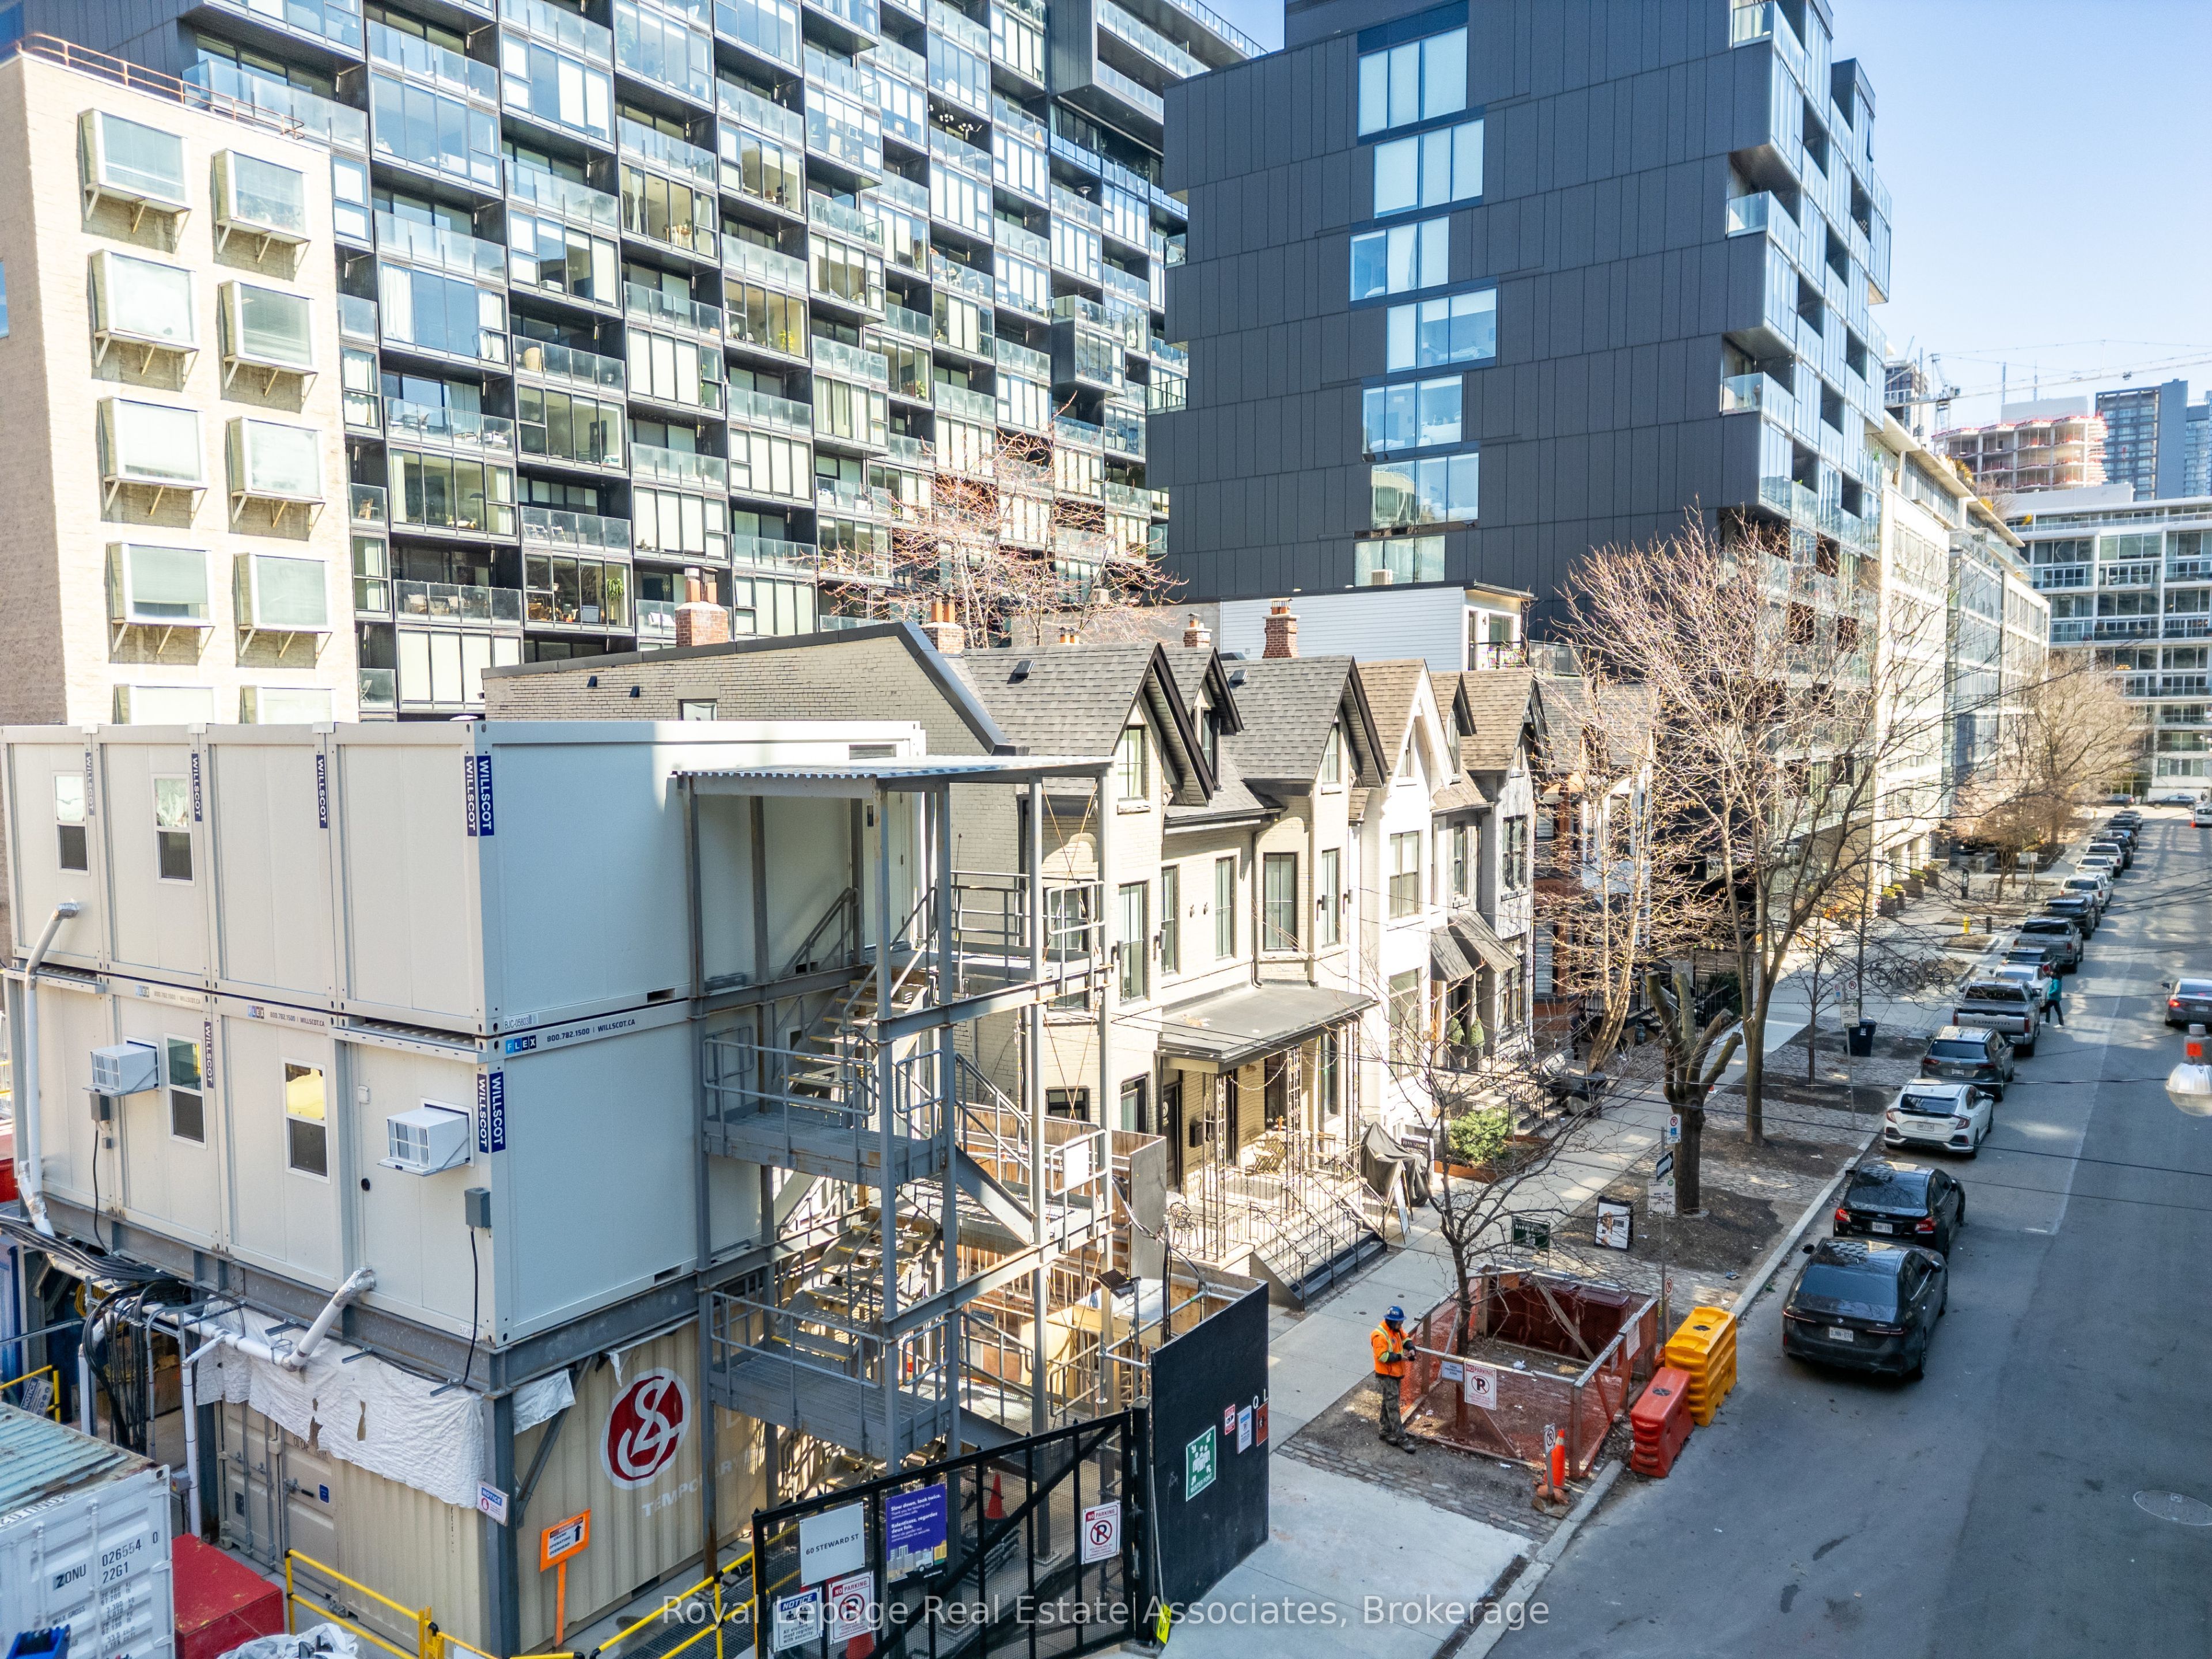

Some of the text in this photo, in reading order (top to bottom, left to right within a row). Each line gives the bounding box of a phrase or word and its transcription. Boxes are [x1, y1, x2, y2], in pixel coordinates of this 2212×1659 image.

[192, 757, 201, 817] WILLSCOT
[317, 759, 327, 823] WILLSCOT
[466, 760, 476, 831] WILLSCOT
[479, 760, 492, 830] WILLSCOT
[180, 995, 200, 1005] WILLSCOT.CA
[248, 1006, 325, 1027] FLEX 800.782.1500 WILLSCOT.CA
[507, 1019, 635, 1052] FLEX 800.782.1500 WILLSCOT.CA
[204, 1025, 213, 1084] WILLSCOT
[479, 1078, 487, 1147] WILLSCOT
[492, 1076, 503, 1145] WILLSCOT
[1475, 1367, 1494, 1377] PARKING
[1190, 1472, 1213, 1494] MUSTER POINT
[482, 1488, 502, 1505] NOTICE
[1096, 1509, 1115, 1518] PARKING
[101, 1539, 142, 1567] 026554
[549, 1536, 571, 1550] OPERATING
[806, 1533, 859, 1555] 60 STEWARD ST
[56, 1562, 128, 1589] ZONU 22G1
[844, 1580, 867, 1592] PARKING
[68, 1605, 86, 1618] GROSS
[782, 1594, 813, 1610] NOTICE
[791, 1624, 808, 1633] visitors
[796, 1626, 814, 1635] register
